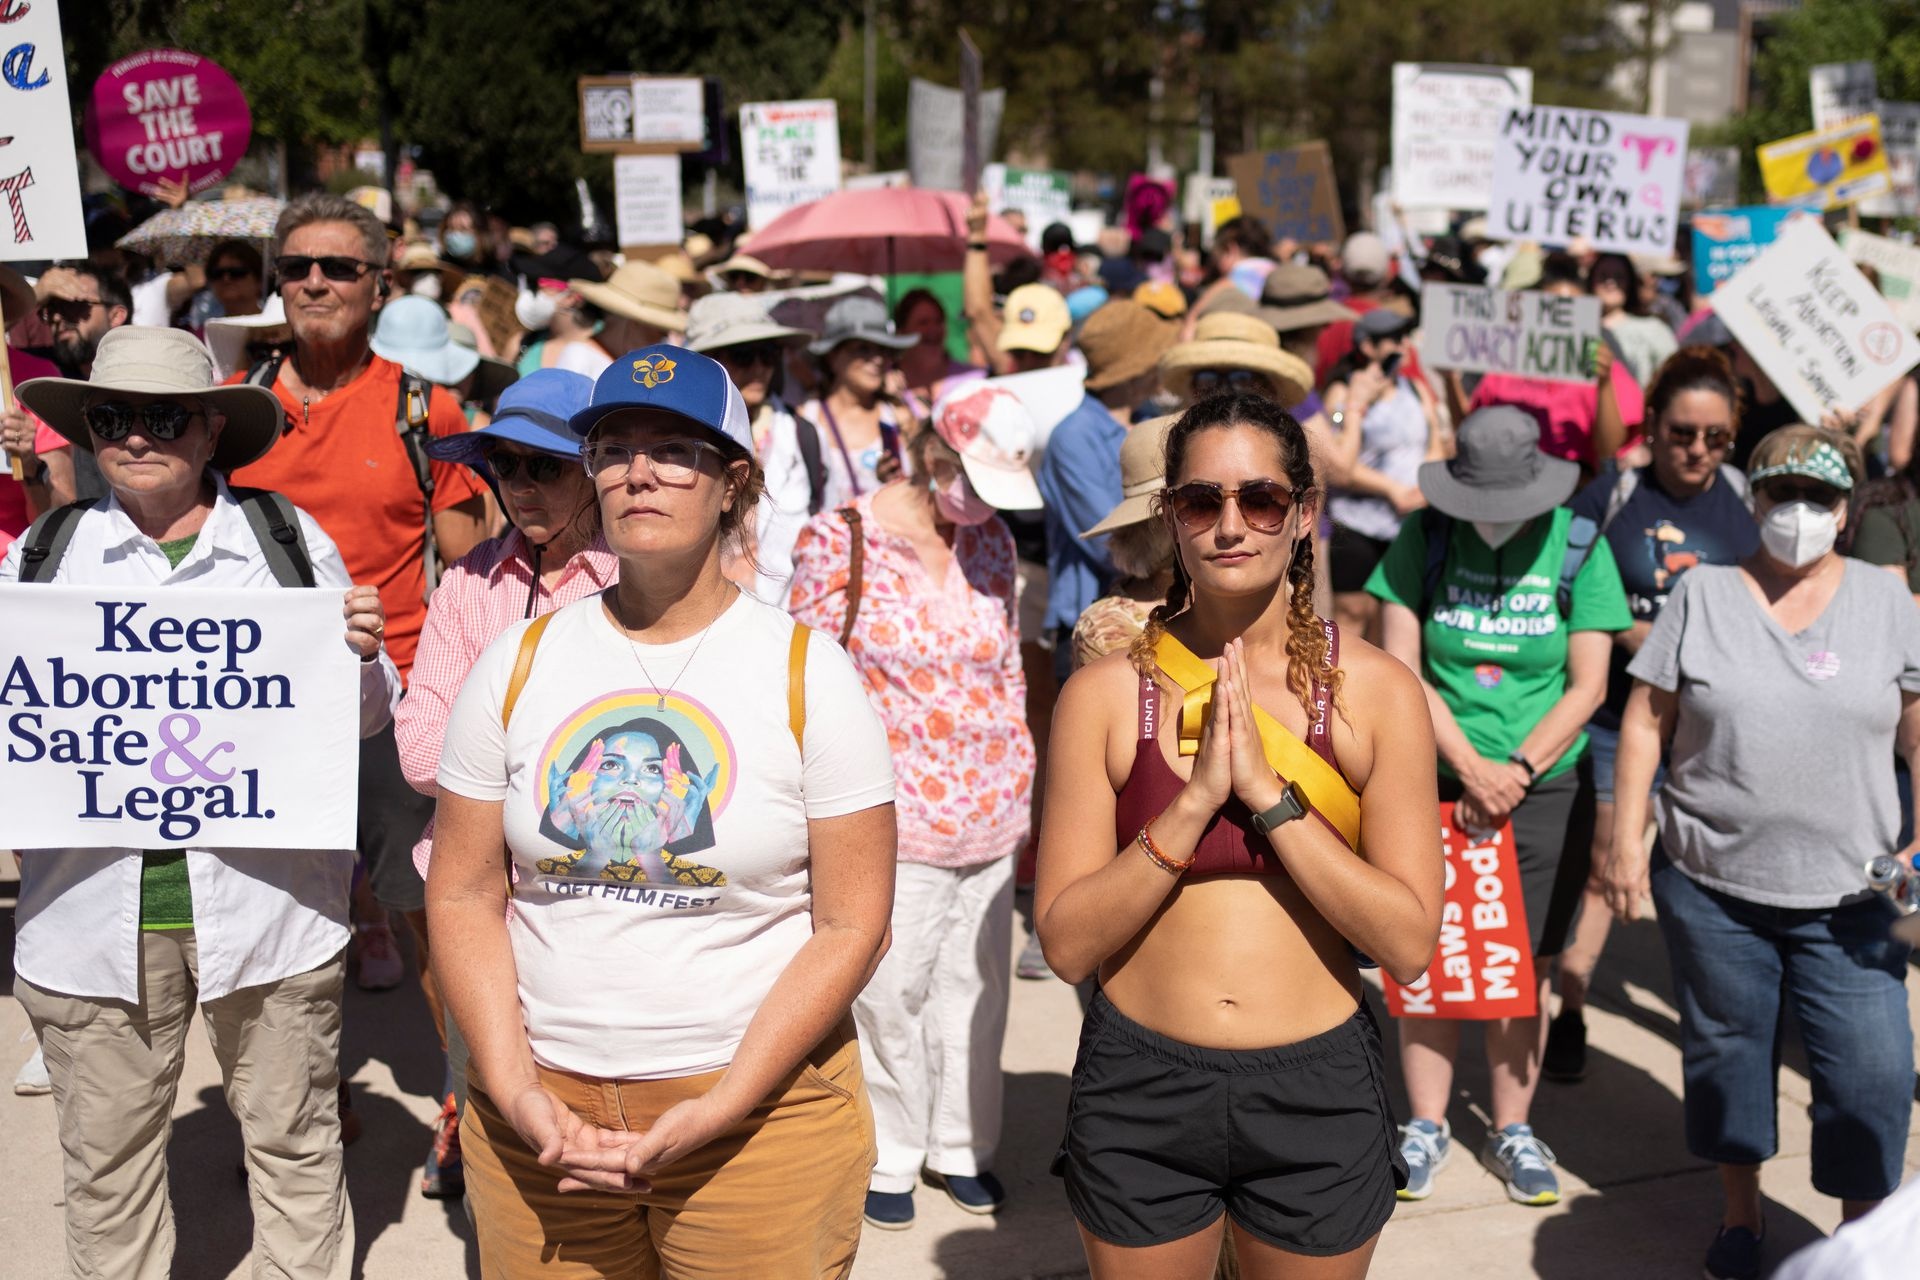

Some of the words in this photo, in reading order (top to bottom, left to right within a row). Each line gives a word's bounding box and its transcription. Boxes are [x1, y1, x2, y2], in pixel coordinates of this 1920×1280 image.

[122, 73, 201, 114] SAVE
[138, 106, 198, 142] THE
[1502, 108, 1612, 147] MIND
[126, 130, 224, 175] COURT
[1514, 140, 1617, 179] YOUR
[1505, 201, 1667, 247] UTERUS
[1449, 288, 1497, 321] THIS
[1537, 297, 1575, 328] ME
[1804, 256, 1860, 317] KEEP
[1745, 281, 1796, 346] LEGAL
[1446, 323, 1523, 371] OVARY
[1433, 605, 1476, 632] OUR
[1478, 613, 1557, 636] BODIES
[1509, 592, 1553, 613] OFF
[95, 601, 262, 673] Keep
[0, 655, 295, 710] Abortion
[8, 712, 149, 766] Safe
[150, 713, 236, 785] &
[77, 768, 276, 841] Legal.
[601, 884, 658, 906] FILM
[659, 892, 721, 910] FEST
[1439, 901, 1476, 1002] Laws
[1481, 940, 1521, 1000] My
